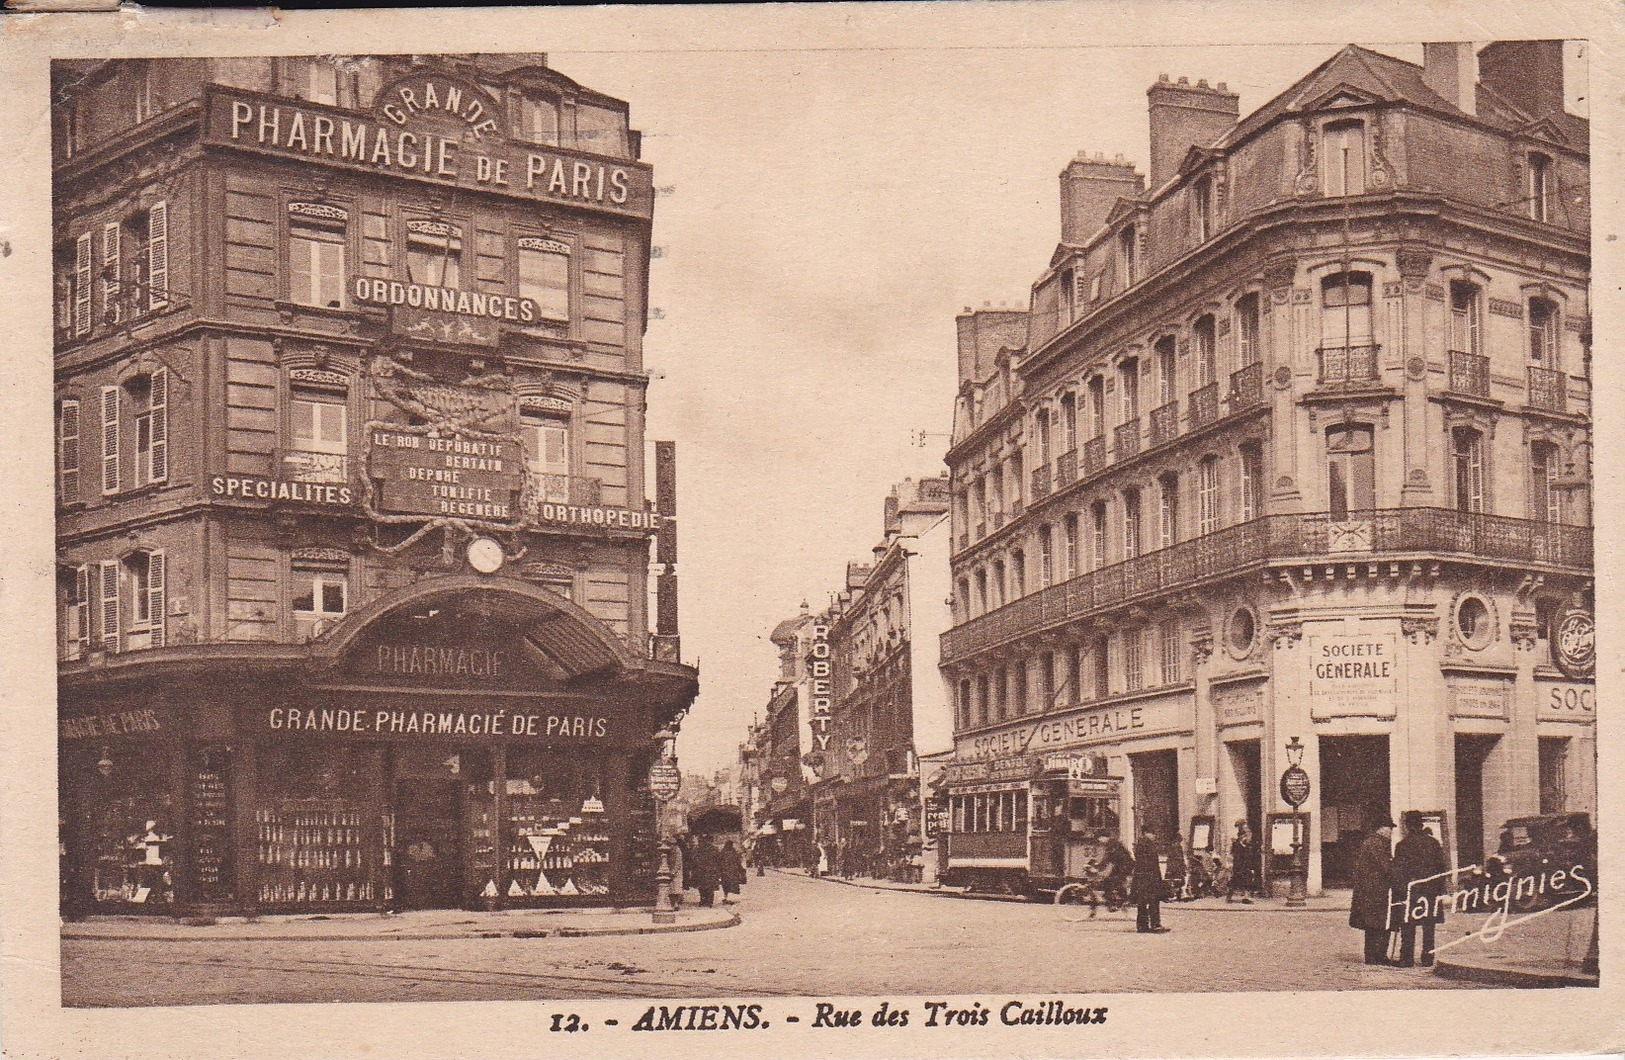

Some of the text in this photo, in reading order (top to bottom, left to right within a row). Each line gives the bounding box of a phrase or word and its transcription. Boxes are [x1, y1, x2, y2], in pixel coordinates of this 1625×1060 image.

[383, 82, 497, 139] GRANDE
[231, 101, 629, 204] PHARMACIE DE PARIS
[356, 278, 534, 321] ORDONNANCES
[375, 433, 390, 446] LE
[212, 477, 351, 505] SPECIALITES
[542, 503, 661, 530] ORTHOPEDIE
[813, 625, 832, 751] ROBERTY
[511, 714, 540, 736] DE
[547, 715, 608, 738] PARIS
